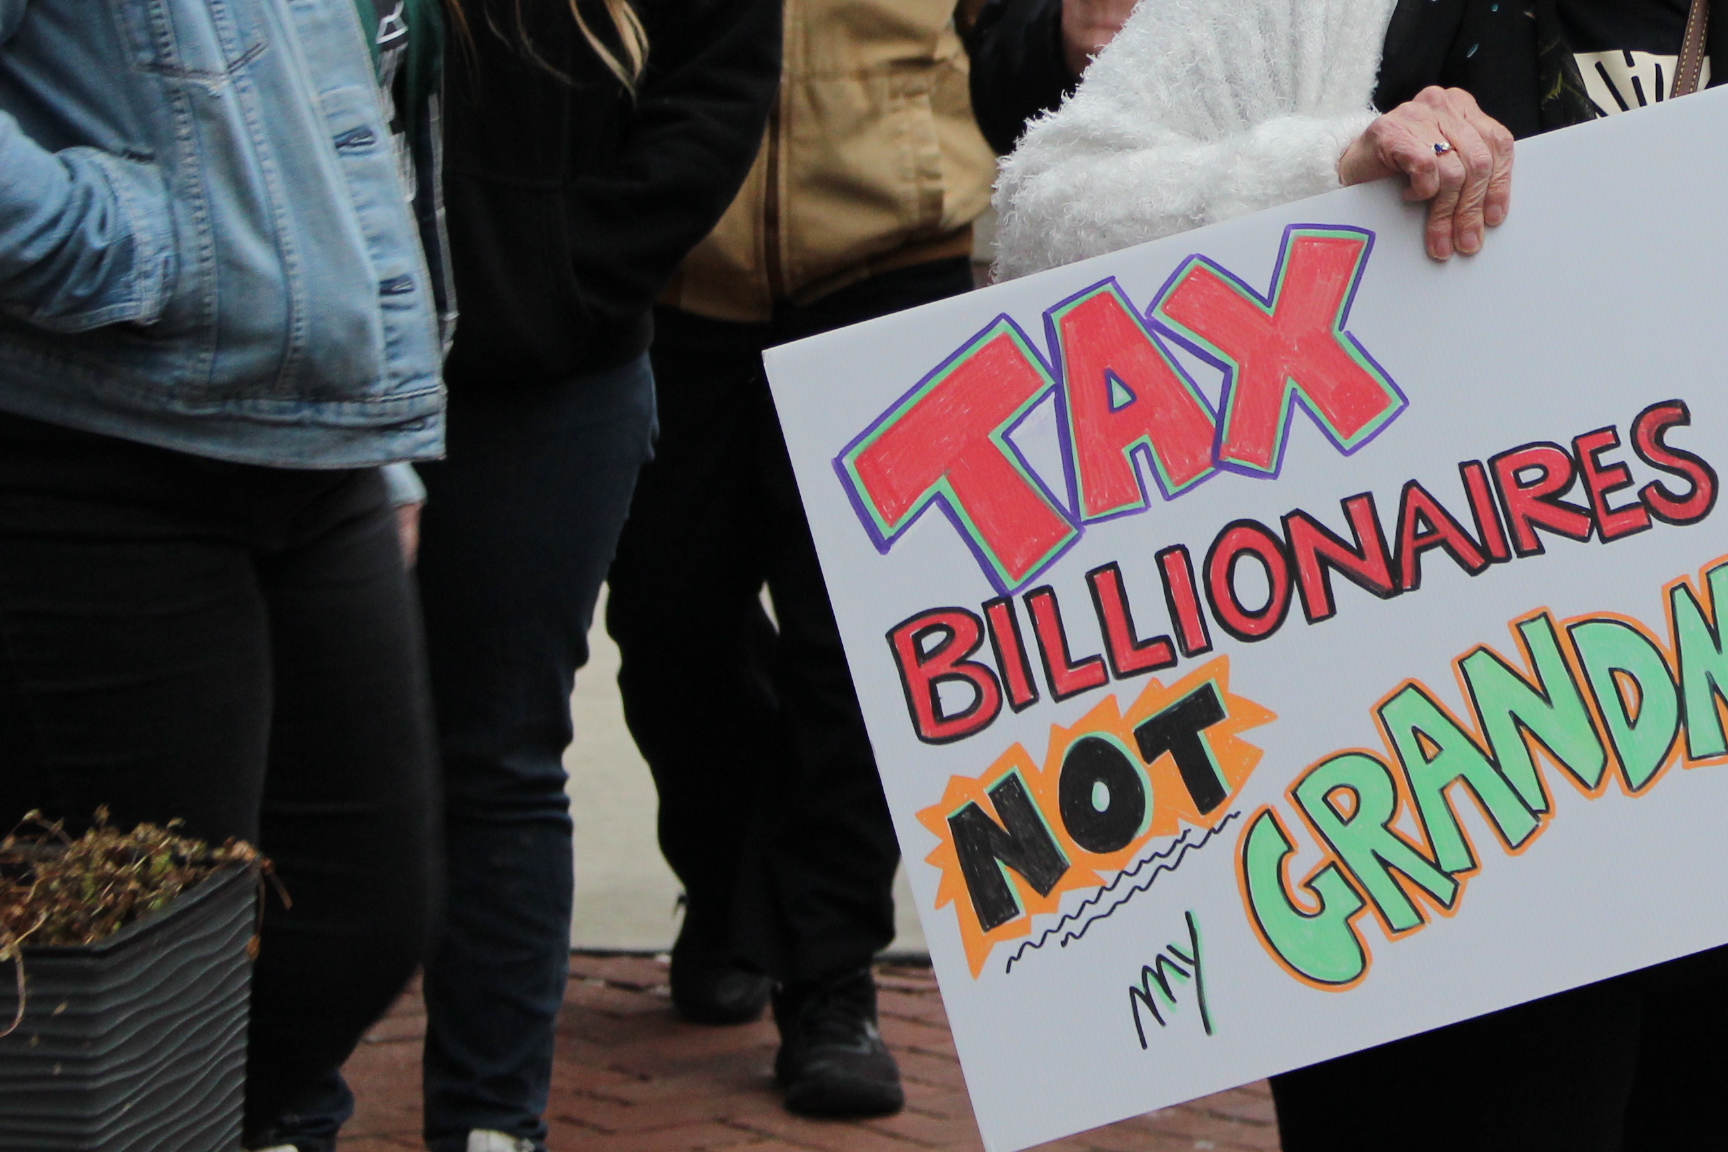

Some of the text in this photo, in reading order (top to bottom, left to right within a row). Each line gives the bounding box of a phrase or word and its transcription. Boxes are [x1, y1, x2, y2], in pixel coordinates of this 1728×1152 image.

[833, 224, 1408, 596] TAX
[886, 399, 1719, 744] BILLIONAIRES
[944, 678, 1236, 934] NOT
